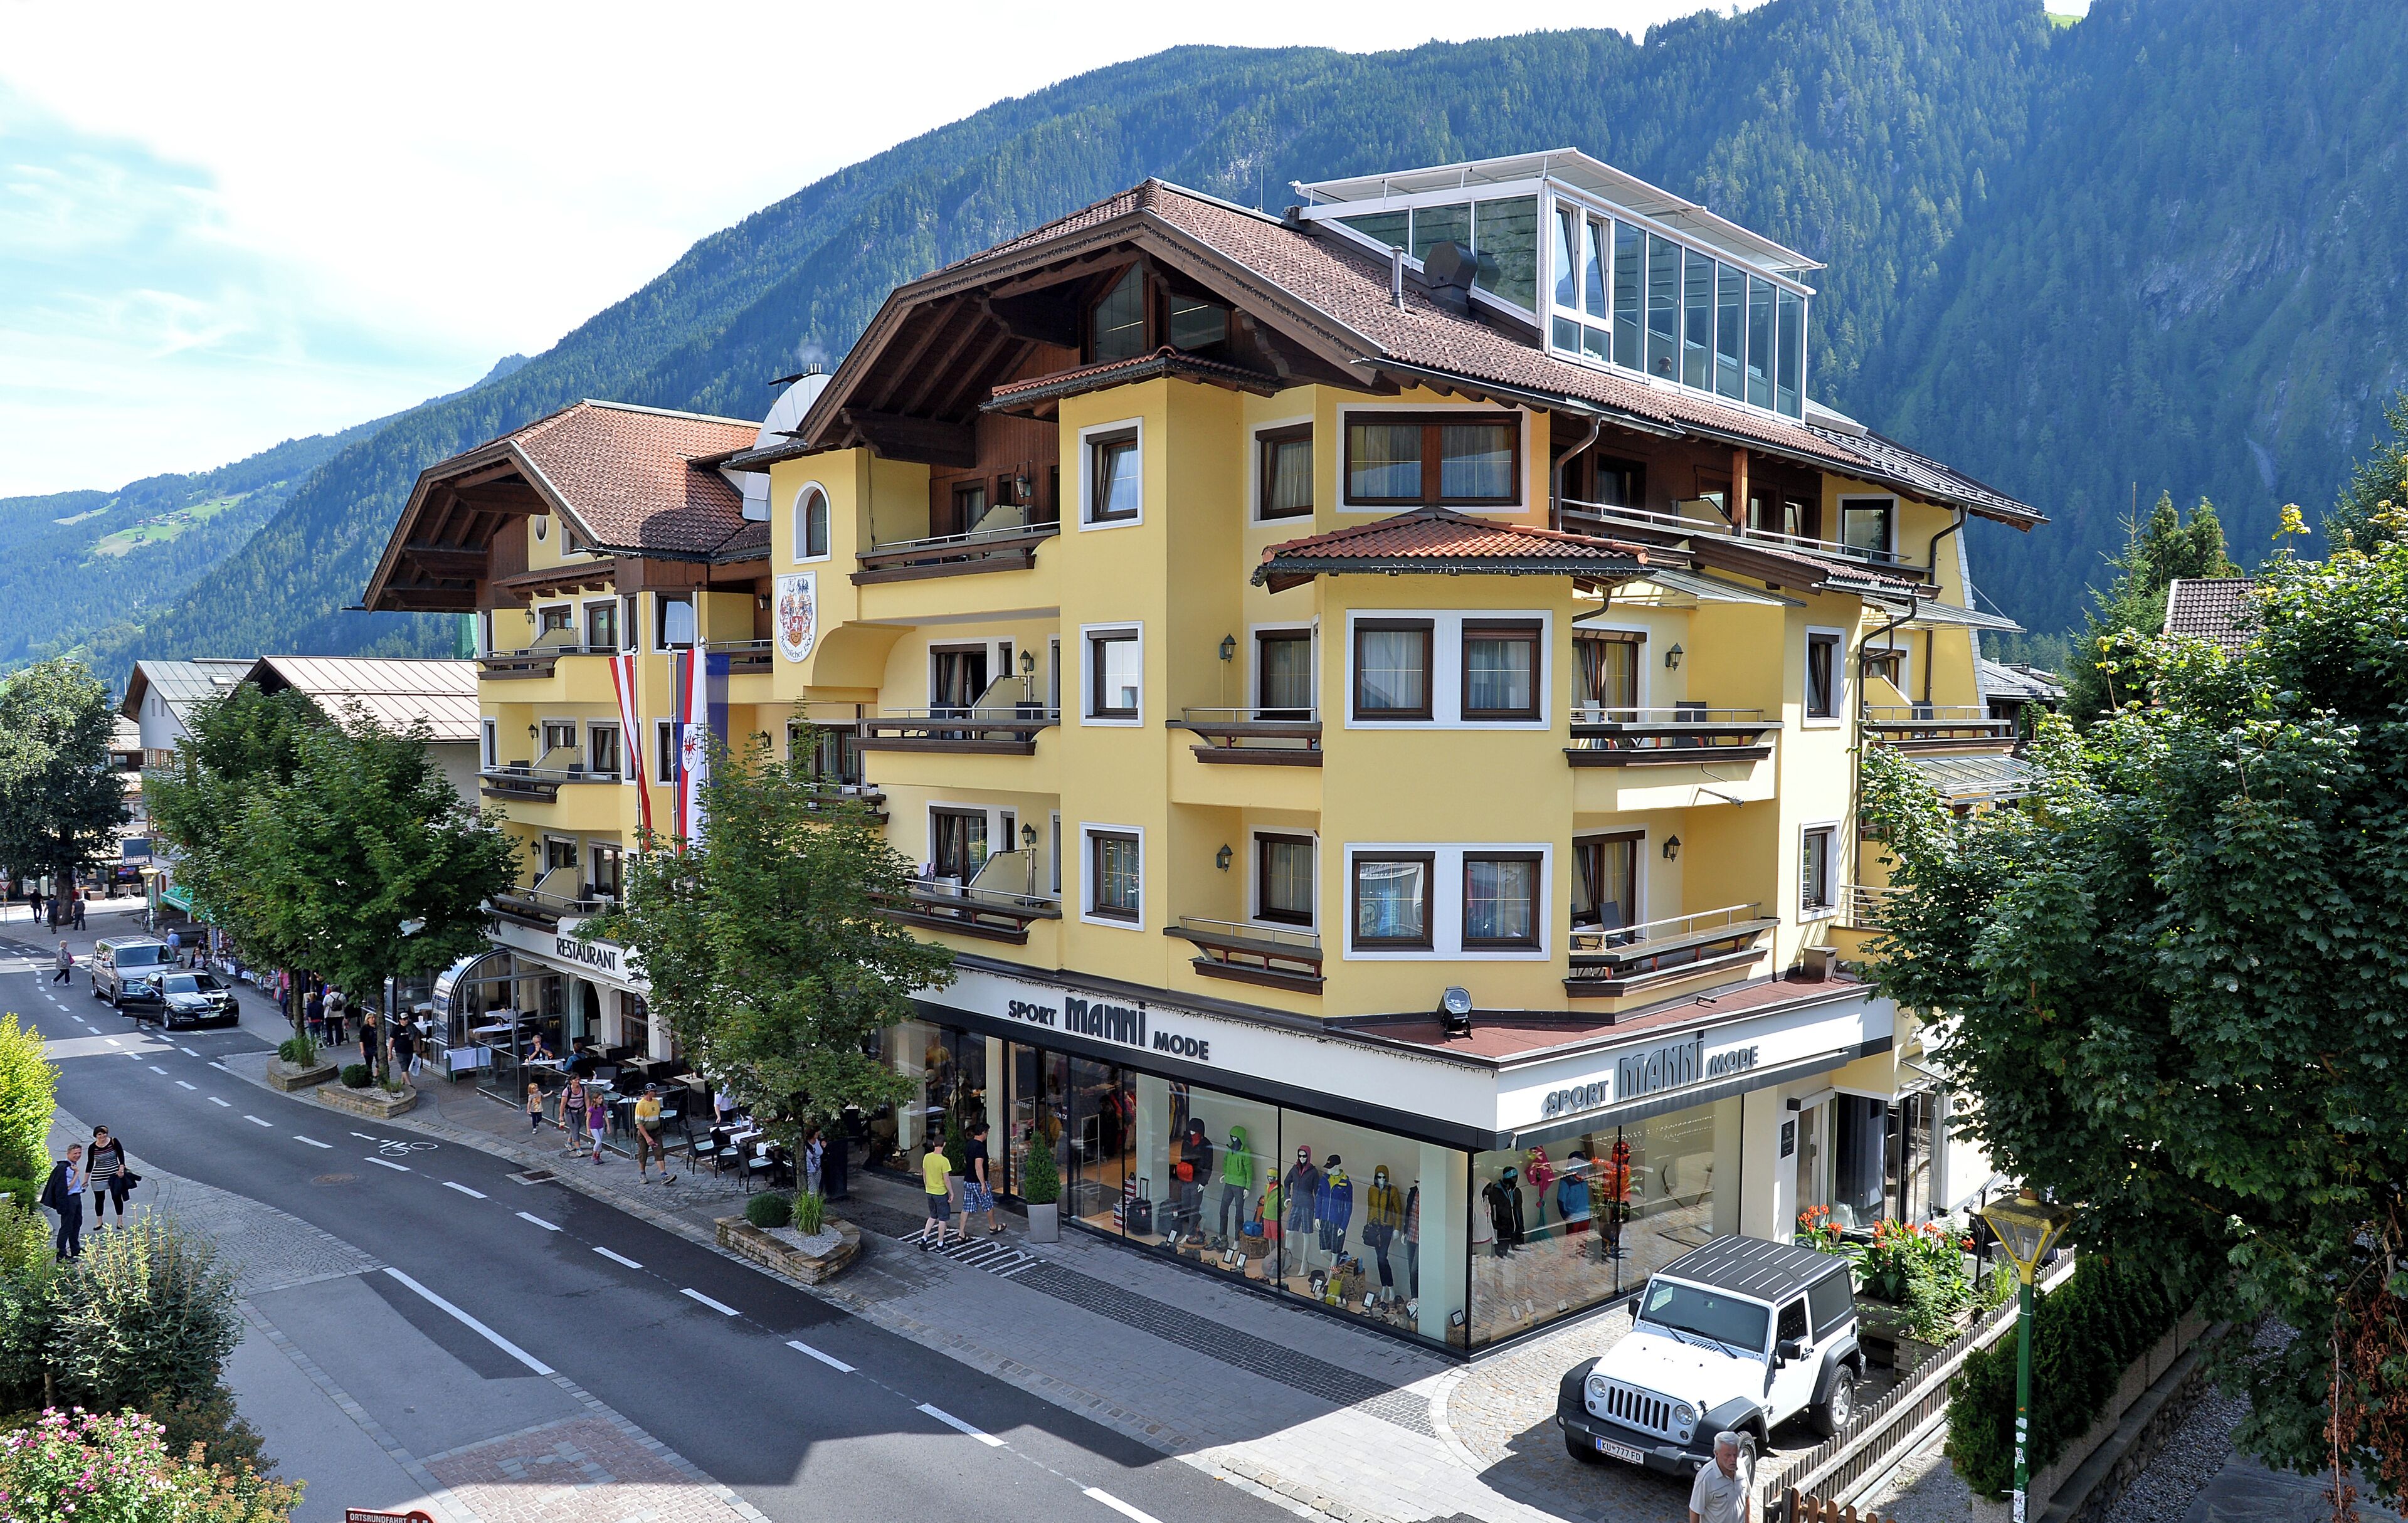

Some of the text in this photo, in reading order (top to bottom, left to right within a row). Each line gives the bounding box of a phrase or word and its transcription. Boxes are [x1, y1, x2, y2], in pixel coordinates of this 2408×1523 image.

[125, 856, 150, 865] SIMPL
[556, 937, 617, 971] RESTAURANT
[1008, 999, 1056, 1026] SPORT
[1153, 1031, 1209, 1061] MODE
[1546, 1080, 1609, 1115] SPORT
[1710, 1045, 1759, 1076] MODE
[1602, 1441, 1640, 1462] KU 777 FD
